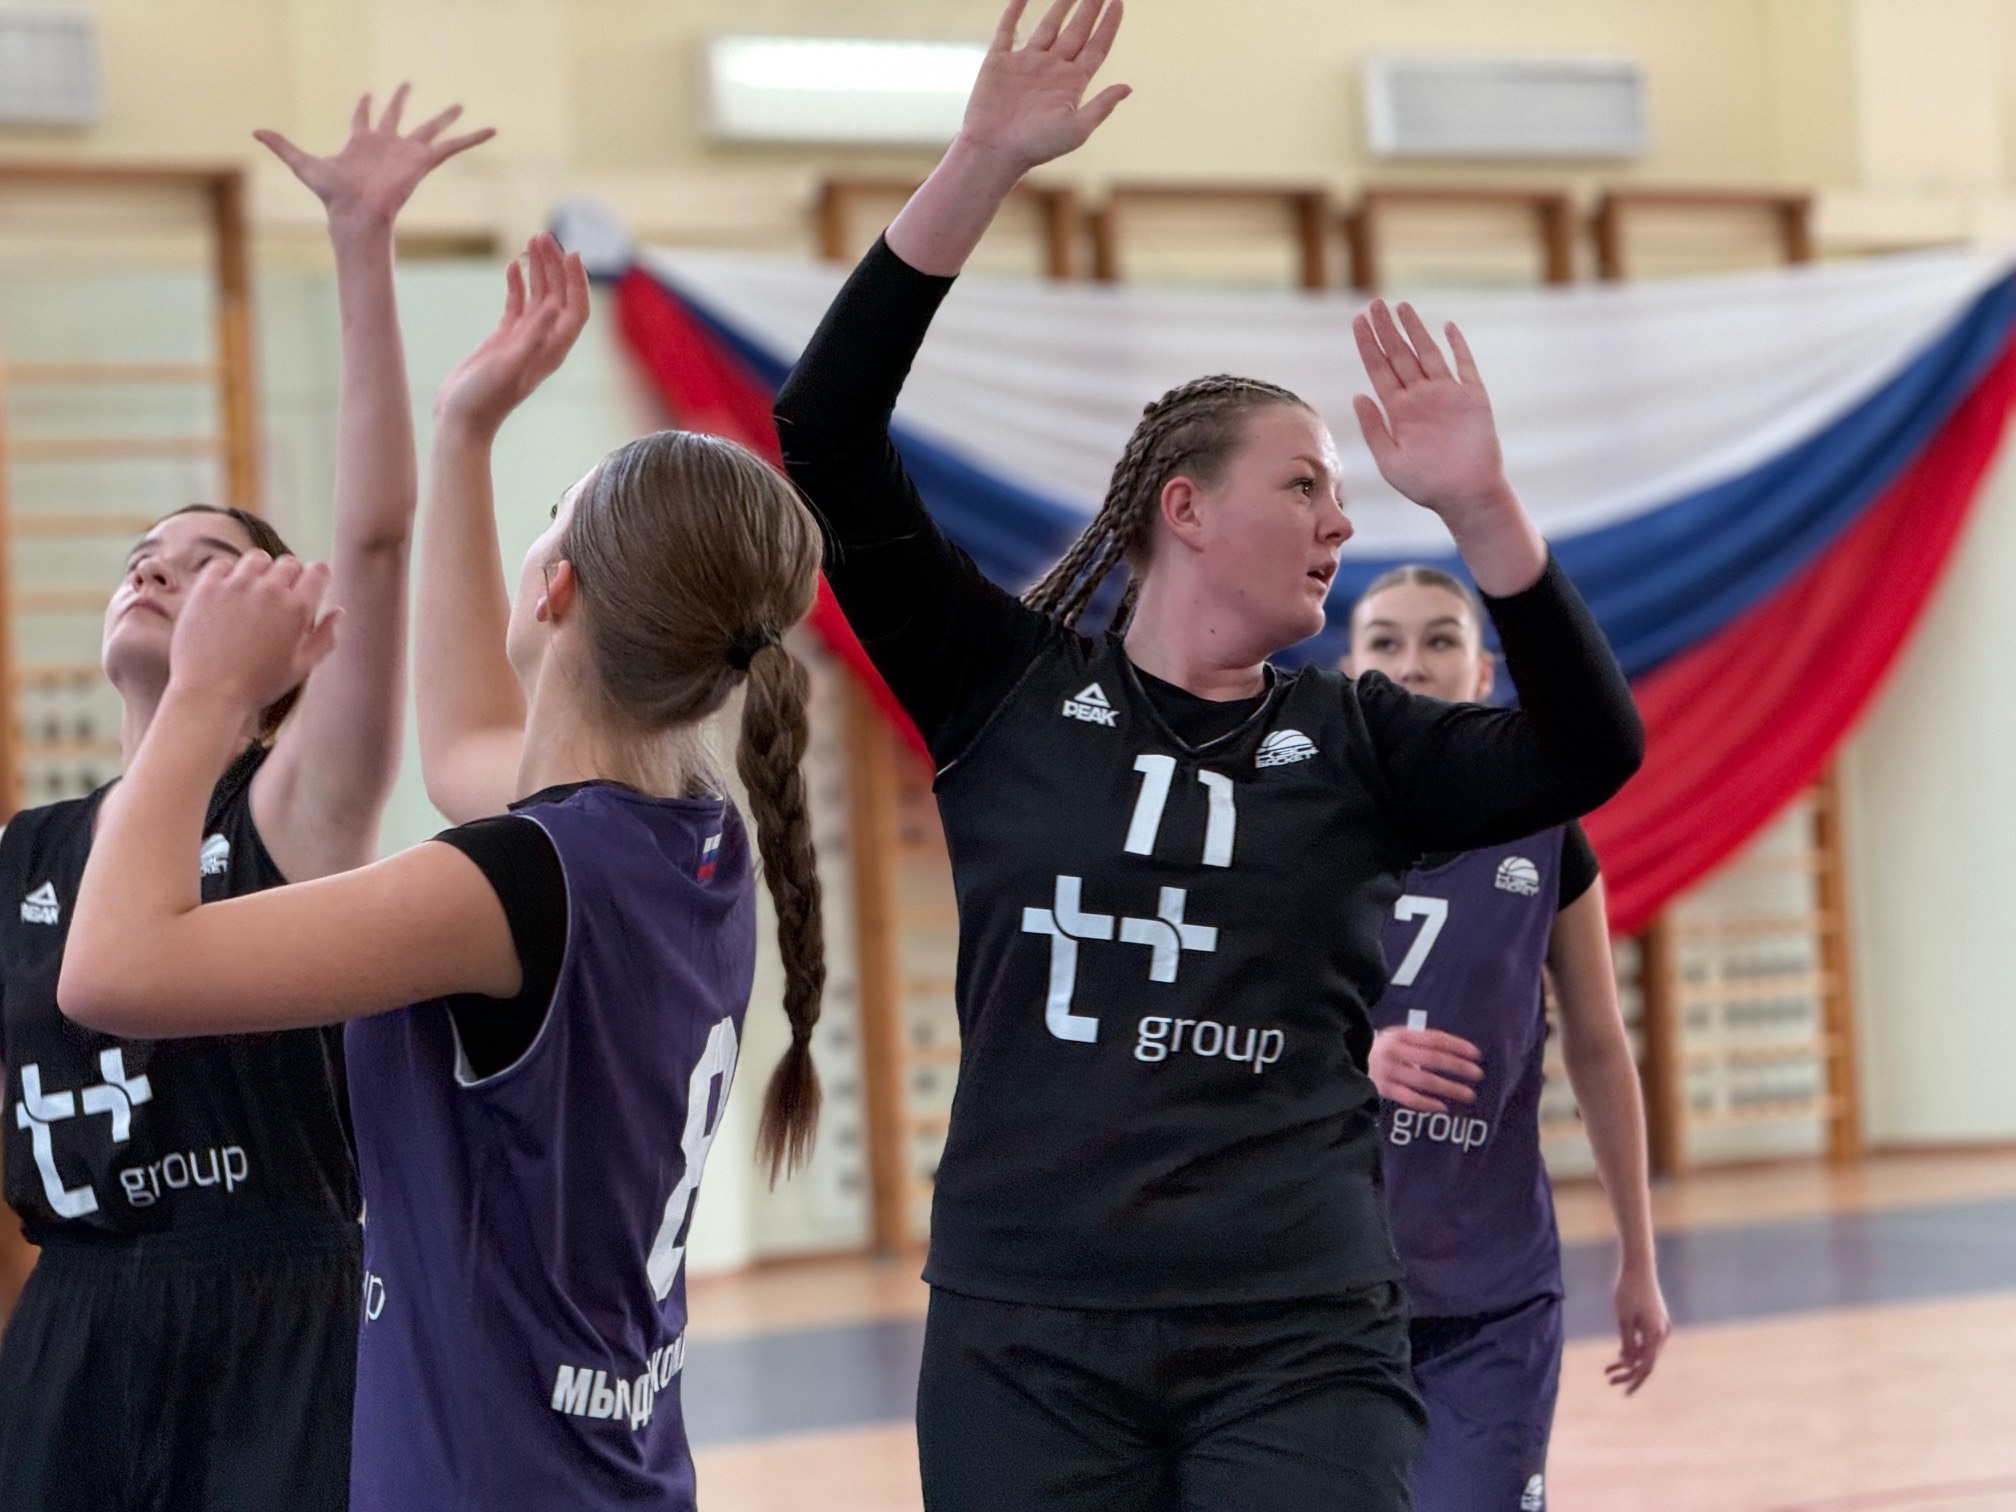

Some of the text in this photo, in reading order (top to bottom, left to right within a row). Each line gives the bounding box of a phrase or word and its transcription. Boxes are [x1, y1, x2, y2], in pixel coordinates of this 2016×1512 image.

[1062, 700, 1120, 728] PEAK
[1124, 754, 1236, 868] 11
[1390, 894, 1449, 987] 7
[1134, 1016, 1286, 1074] group
[646, 1015, 739, 1302] 8
[1390, 1107, 1488, 1153] group
[120, 1145, 249, 1207] group
